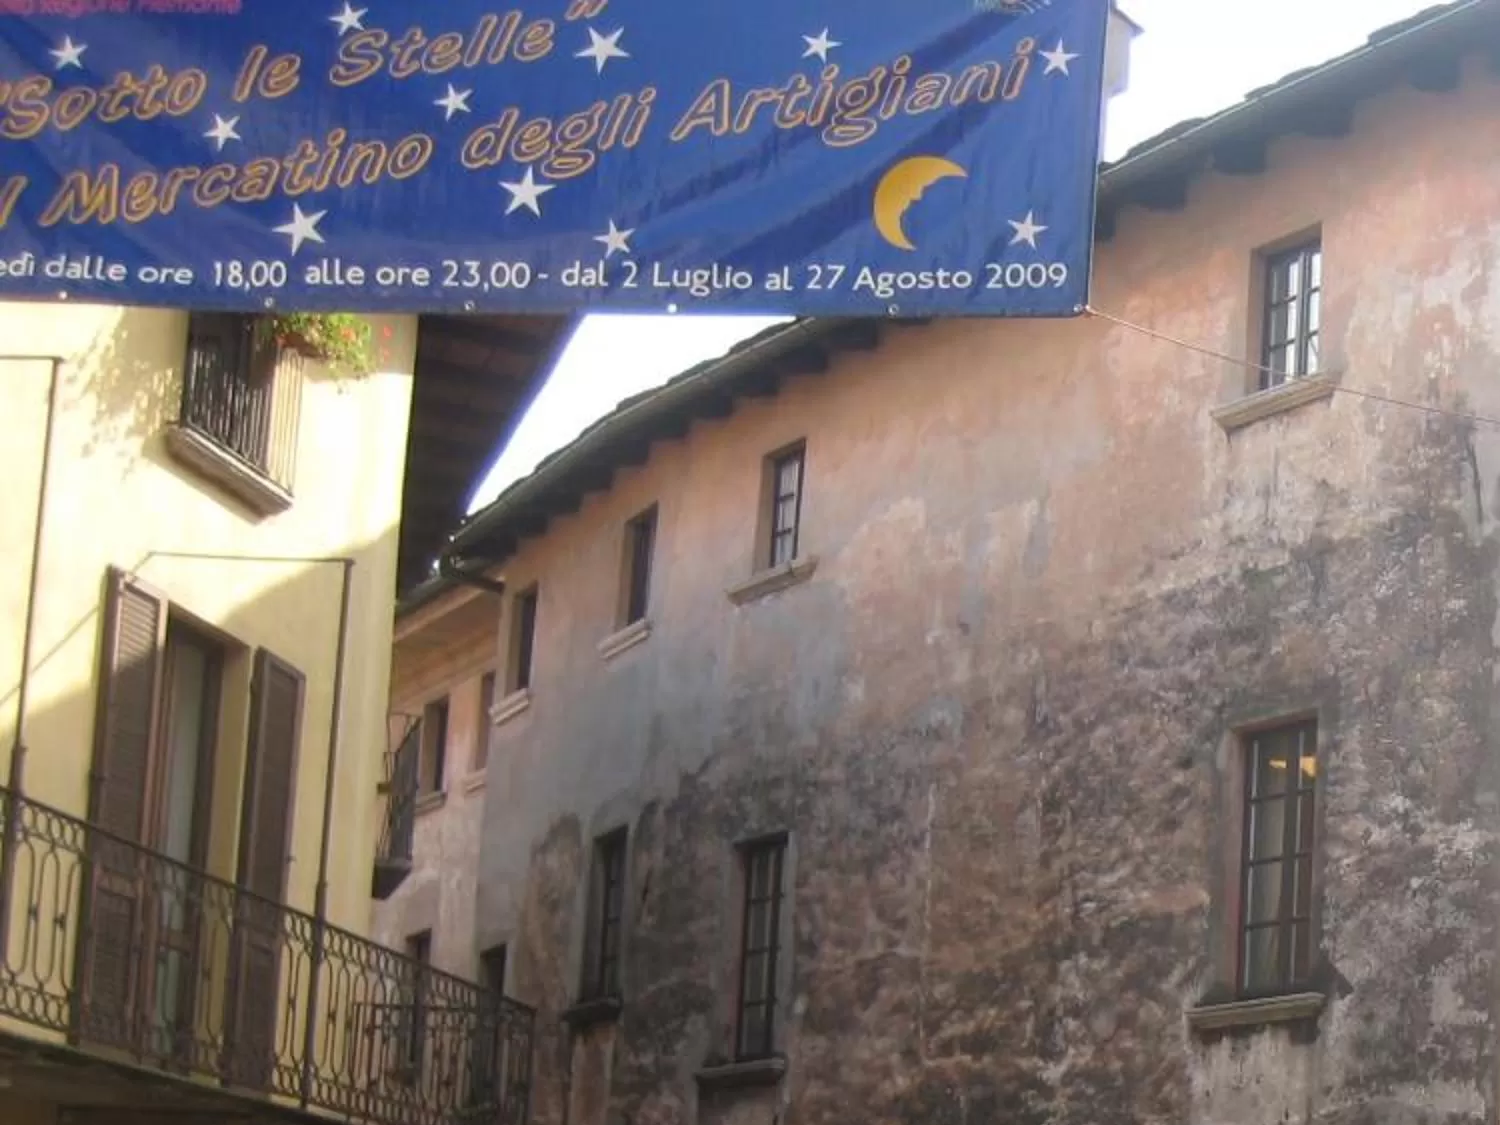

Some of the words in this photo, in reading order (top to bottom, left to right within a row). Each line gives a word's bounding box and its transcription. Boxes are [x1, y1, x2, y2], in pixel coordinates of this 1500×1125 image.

[233, 44, 301, 102] le
[38, 128, 433, 228] Mercatino
[461, 86, 657, 180] degli
[671, 37, 1036, 148] Artigiani
[44, 254, 128, 282] dalle
[137, 265, 194, 286] ore
[213, 259, 288, 292] 18,00
[305, 258, 366, 286] alle
[375, 265, 431, 287] ore
[442, 260, 531, 292] 23,00
[561, 260, 609, 288] dal
[622, 263, 638, 288] 2
[652, 262, 753, 296] Luglio
[764, 264, 792, 290] al
[806, 264, 844, 290] 27
[852, 265, 973, 298] Agosto
[985, 262, 1068, 289] 2009
